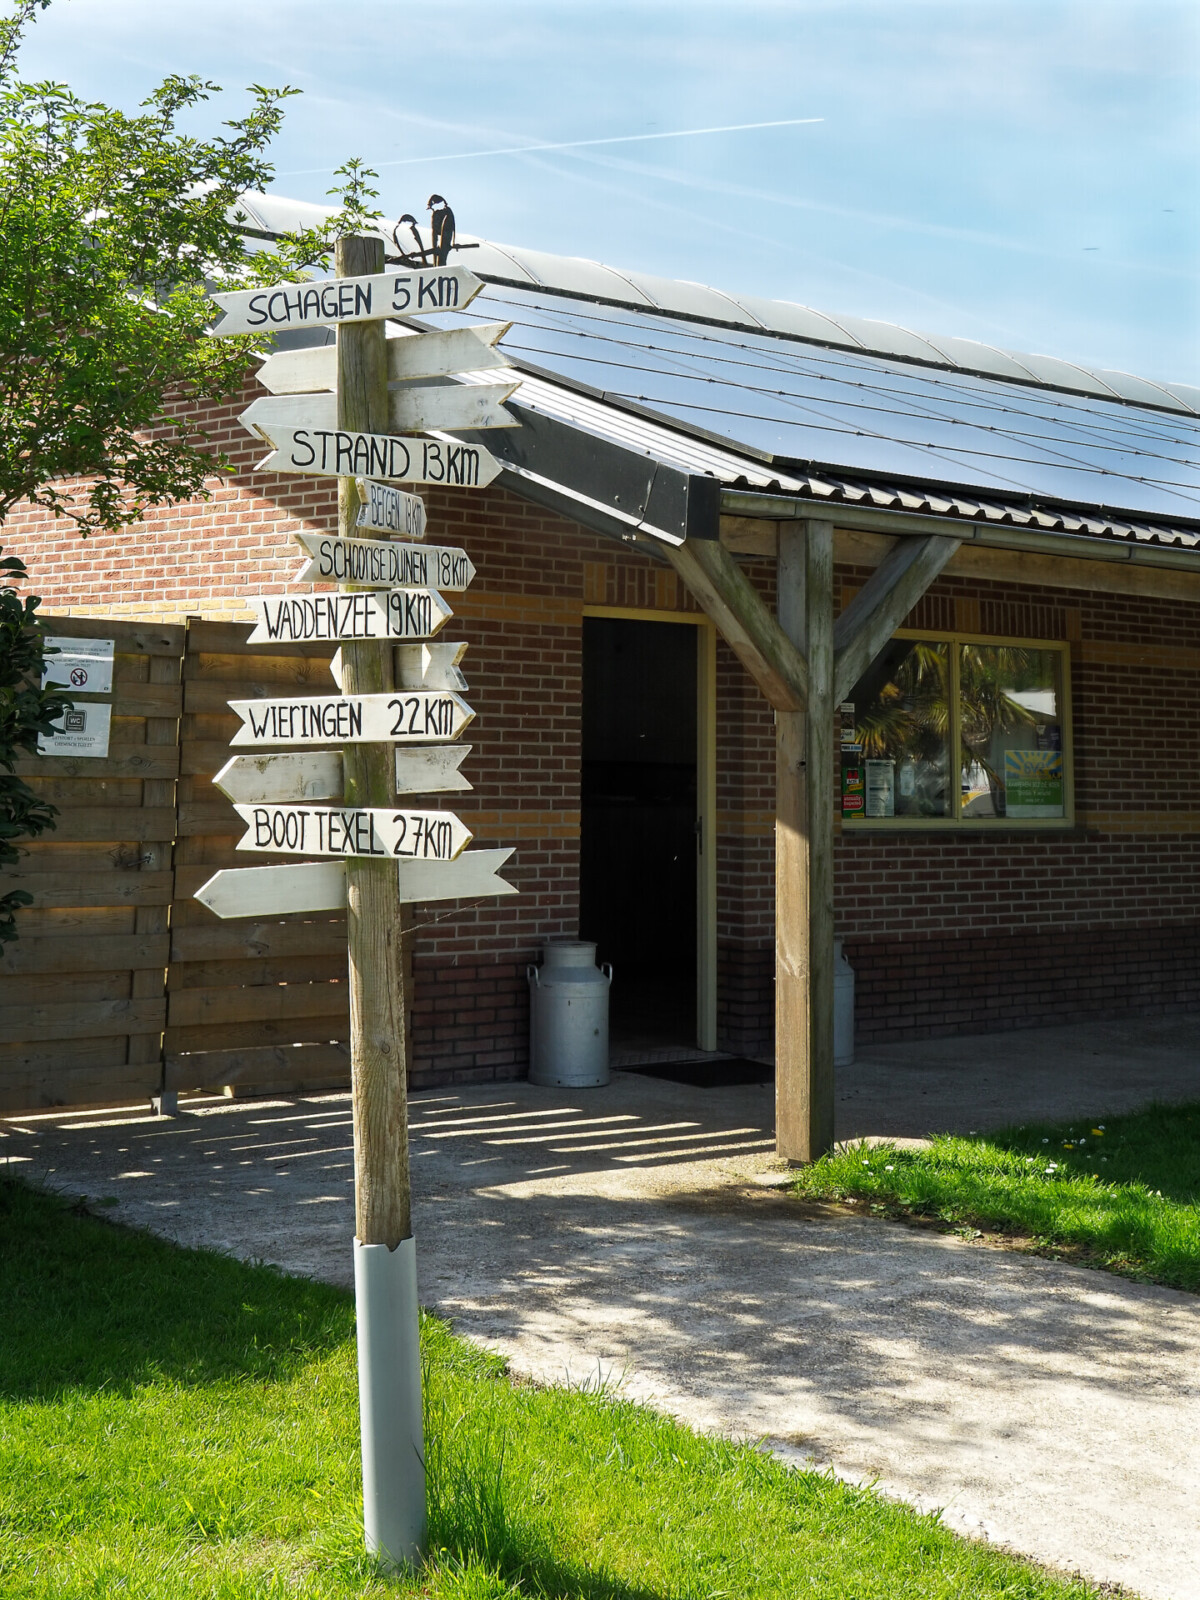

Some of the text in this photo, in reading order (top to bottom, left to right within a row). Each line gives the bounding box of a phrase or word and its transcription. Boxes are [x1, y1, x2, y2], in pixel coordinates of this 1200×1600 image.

[247, 282, 372, 325] SCHAGEN
[291, 430, 410, 478] STRAND
[263, 594, 376, 640] WADDENZEE
[253, 808, 310, 849] BOOT
[315, 811, 384, 856] TEXEL
